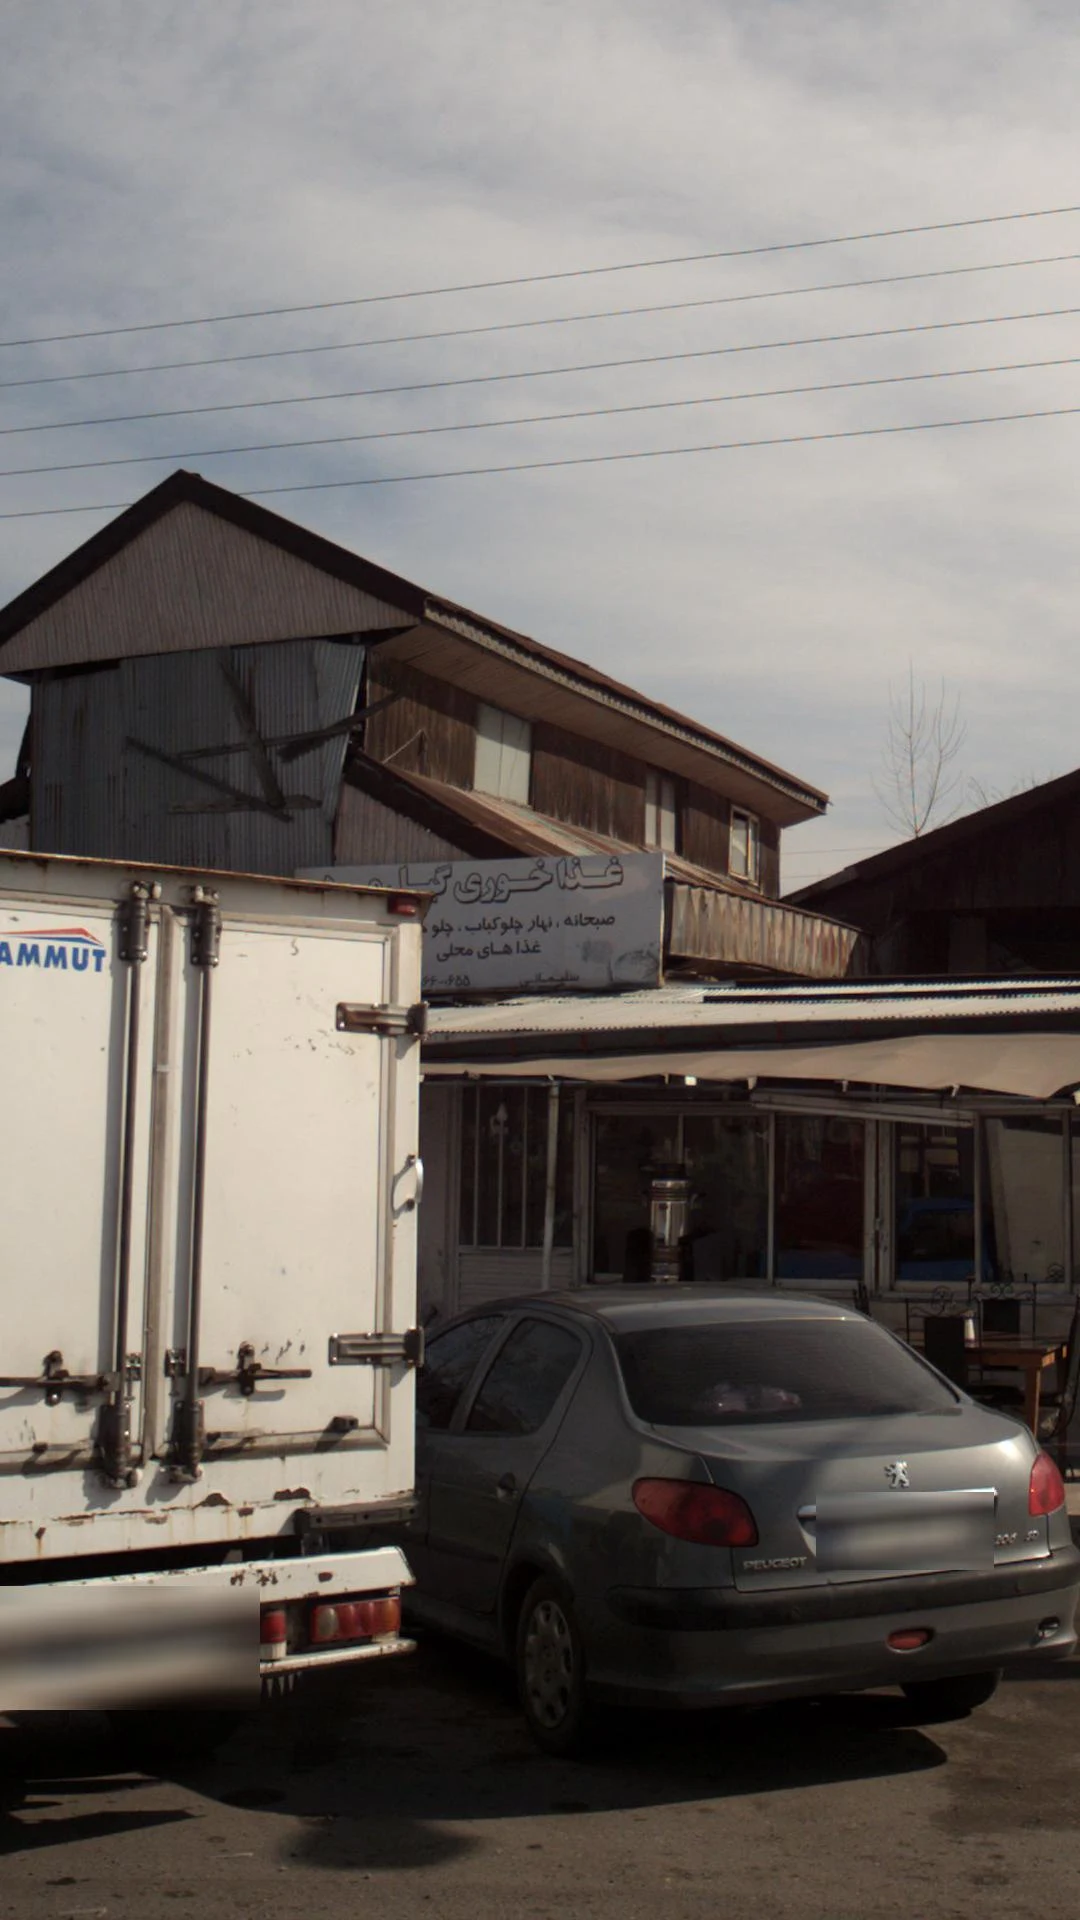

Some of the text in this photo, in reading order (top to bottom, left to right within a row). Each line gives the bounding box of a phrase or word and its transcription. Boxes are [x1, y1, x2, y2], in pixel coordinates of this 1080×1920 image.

[453, 858, 553, 904] خوری
[556, 856, 624, 890] غذا
[743, 1556, 808, 1570] PEUGEOT
